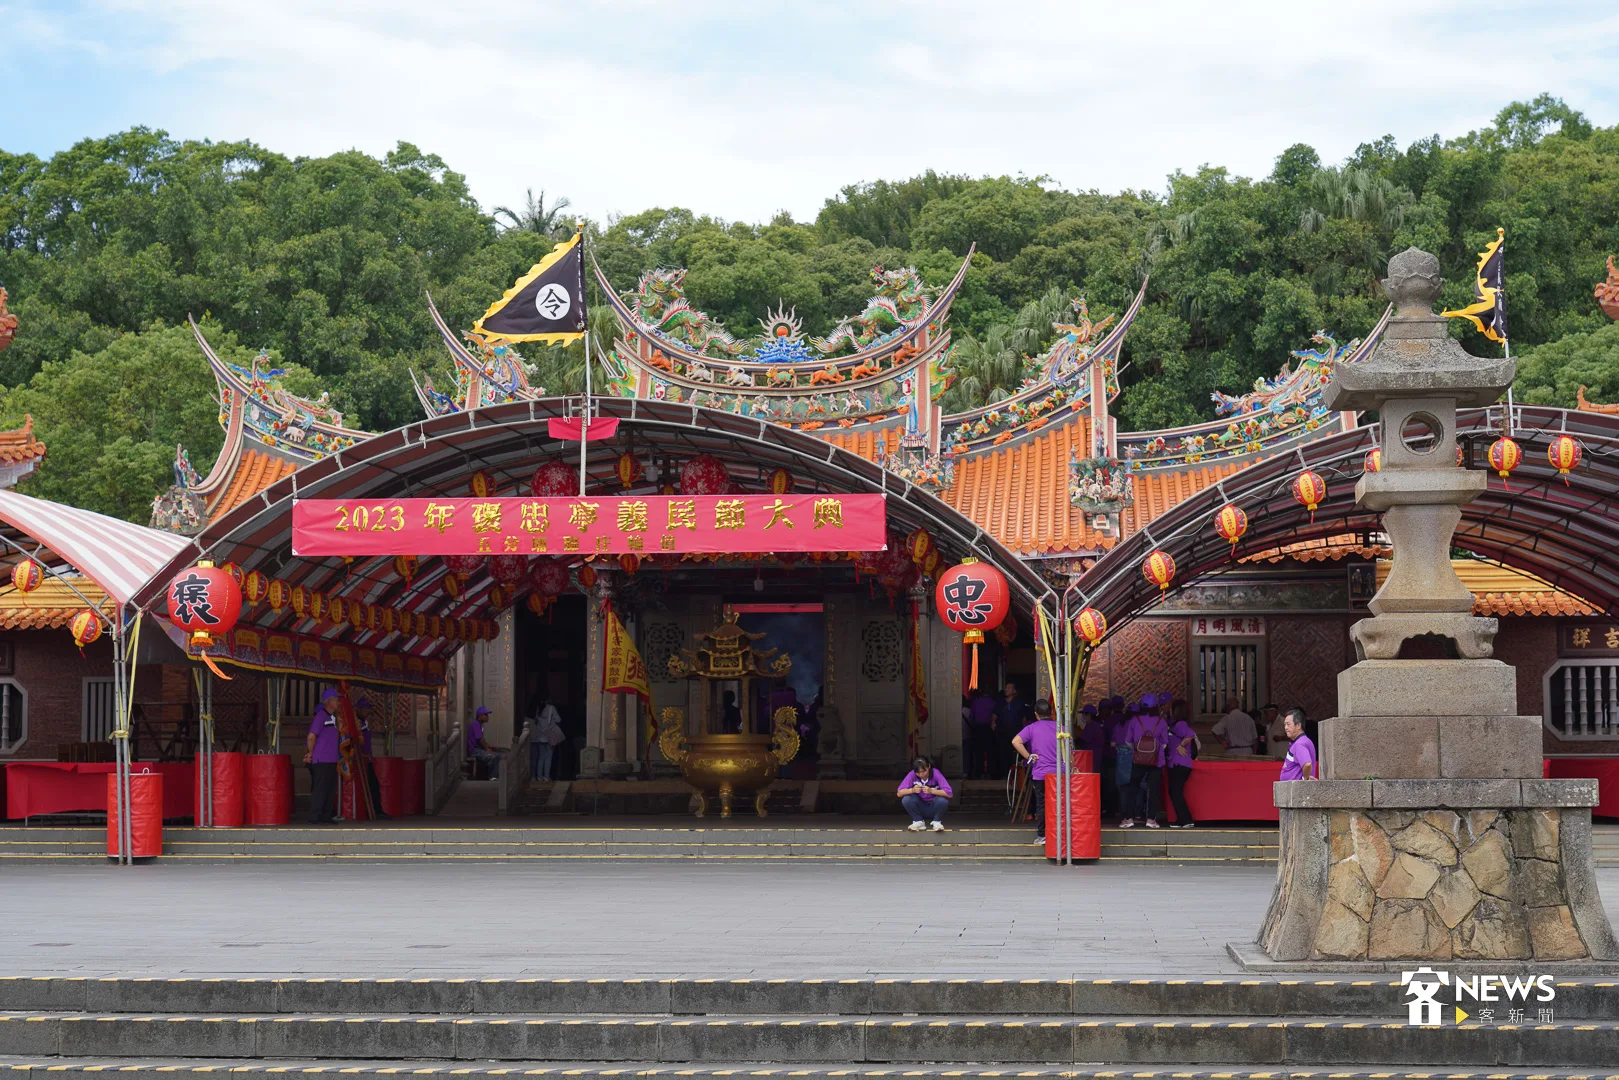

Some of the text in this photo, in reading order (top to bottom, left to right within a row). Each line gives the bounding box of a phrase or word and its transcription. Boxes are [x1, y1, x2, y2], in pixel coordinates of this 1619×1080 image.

[540, 288, 568, 318] 令
[172, 572, 221, 625] 褒
[943, 573, 993, 625] 忠
